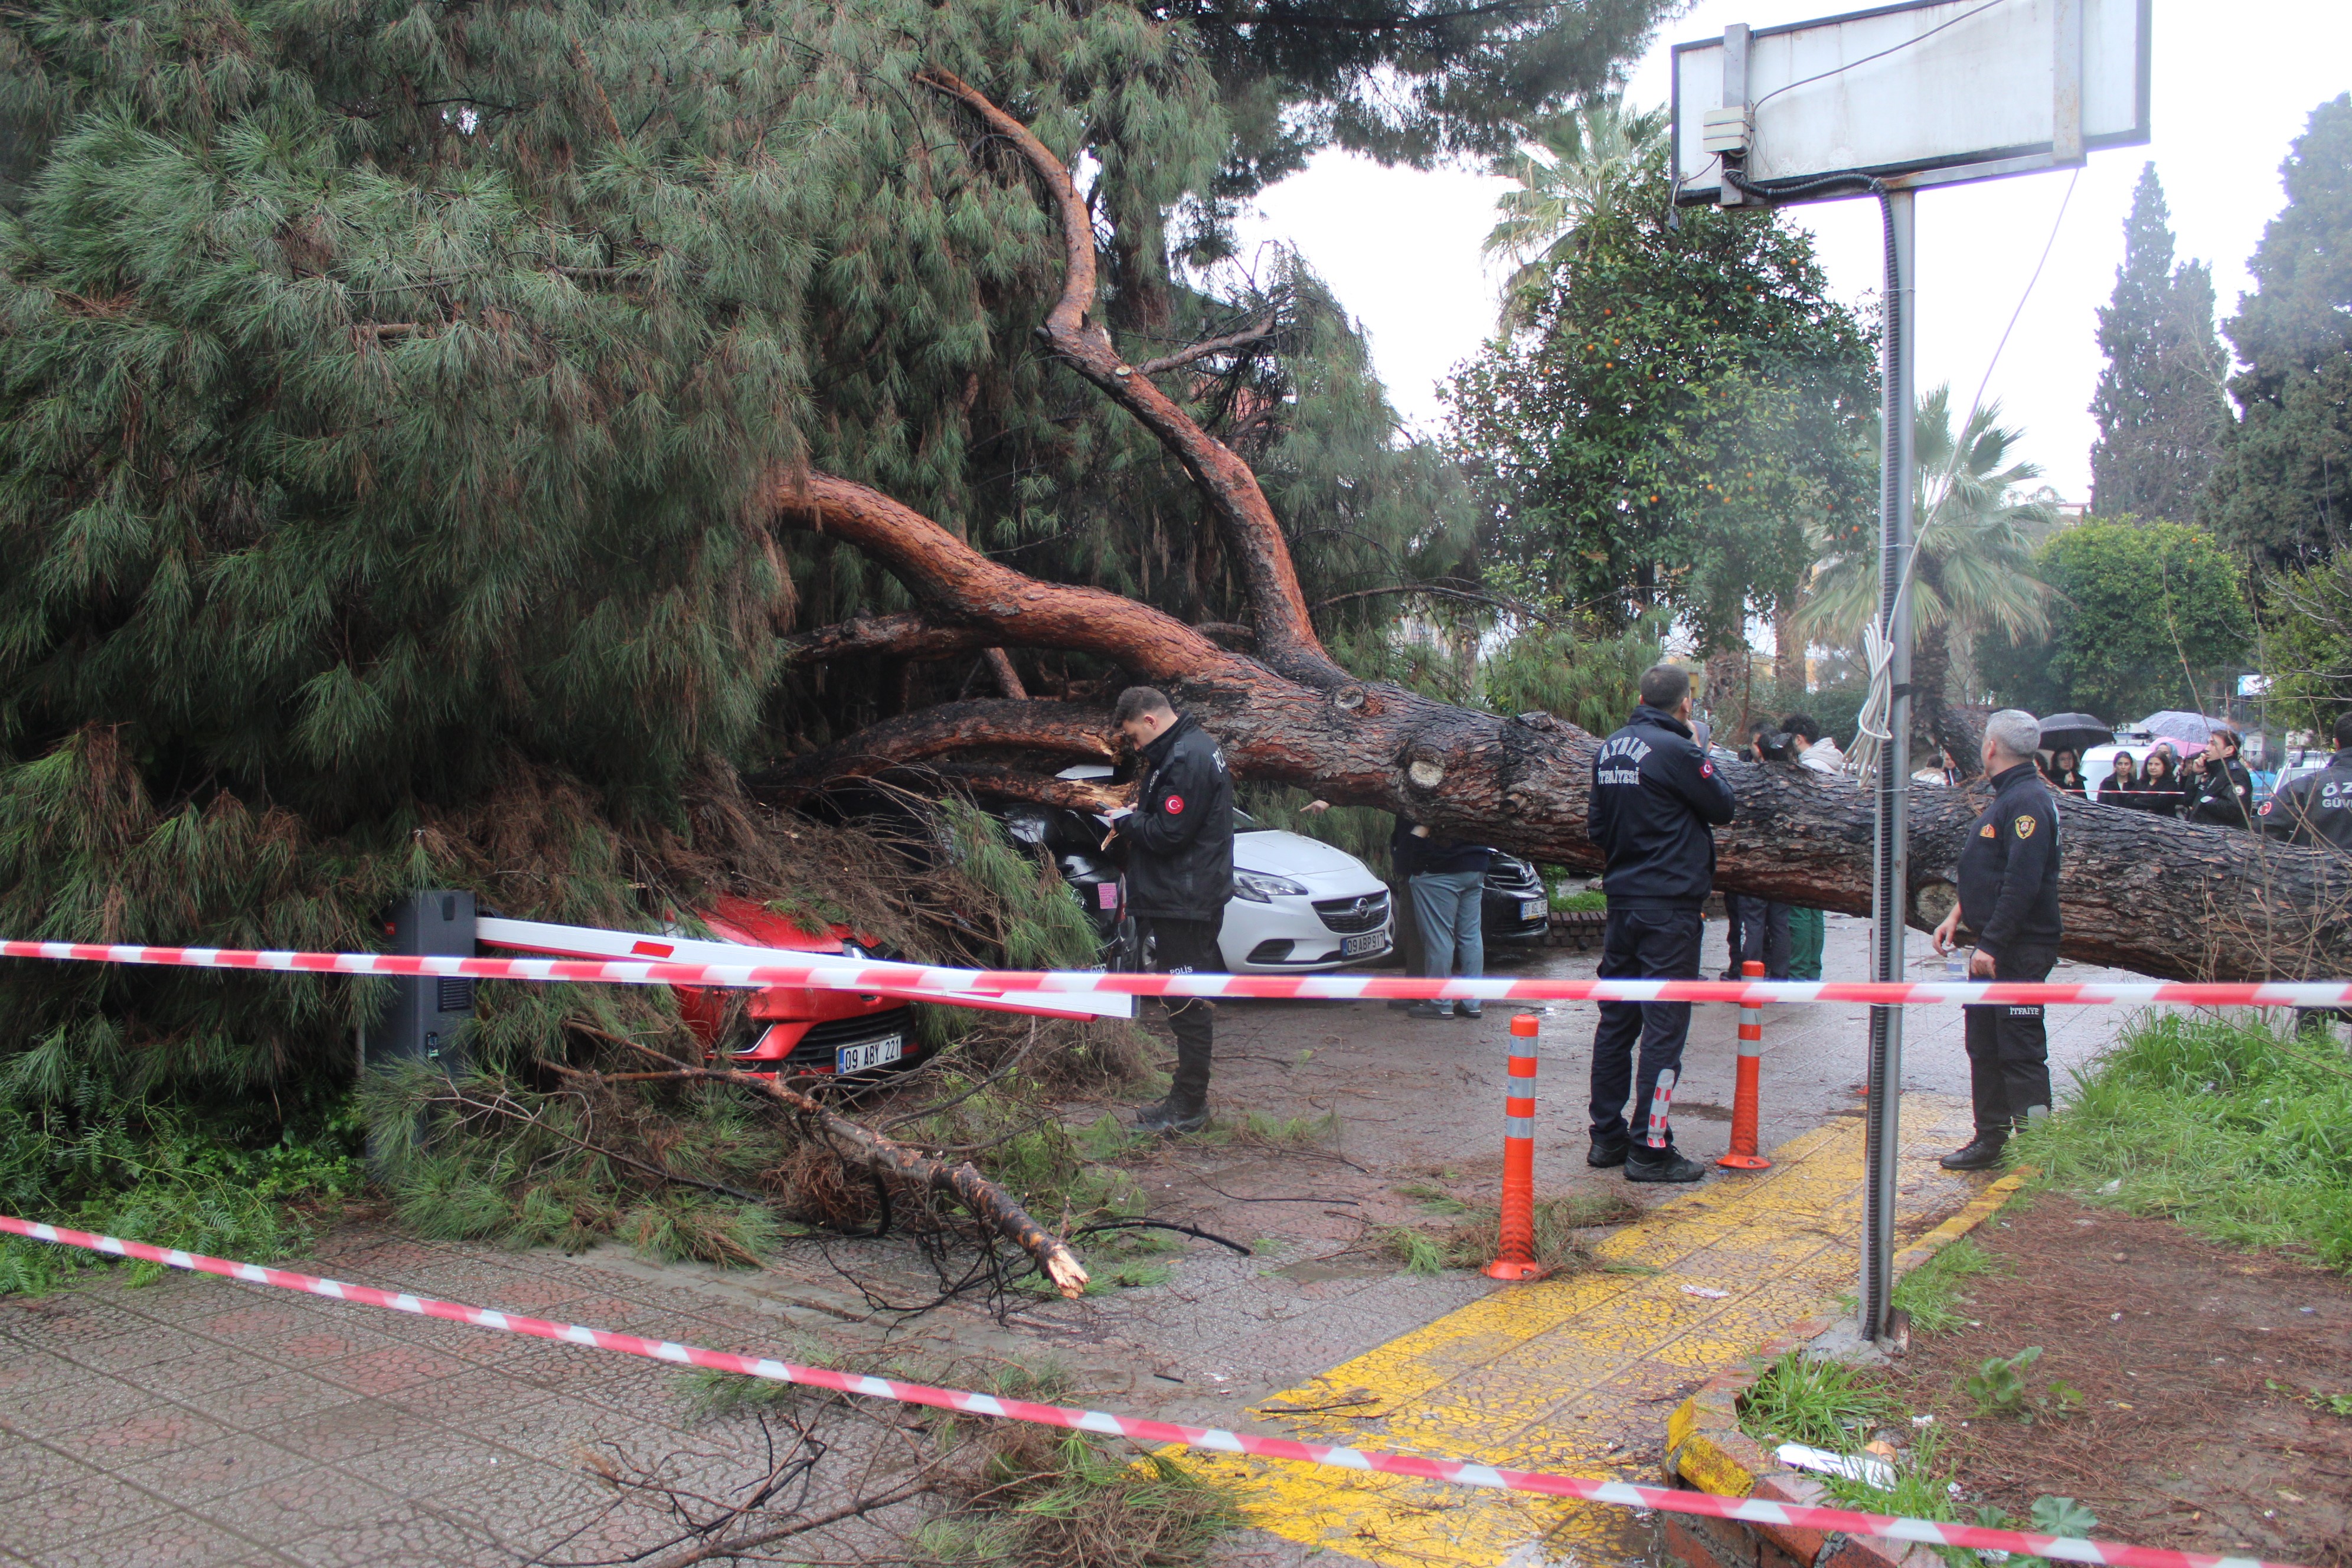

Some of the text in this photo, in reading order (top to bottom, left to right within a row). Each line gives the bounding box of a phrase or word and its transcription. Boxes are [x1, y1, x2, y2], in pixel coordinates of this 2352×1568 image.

[1599, 737, 1652, 765] AYDIN
[1598, 766, 1639, 785] İTFAİYESİ
[2321, 798, 2352, 808] GÜV
[1347, 933, 1383, 953] 09 ABP 917
[1170, 965, 1193, 975] POLİS
[2009, 1006, 2039, 1015] İTFAİYE
[845, 1049, 858, 1070] 09
[864, 1043, 880, 1066] ABY
[886, 1038, 899, 1060] 221
